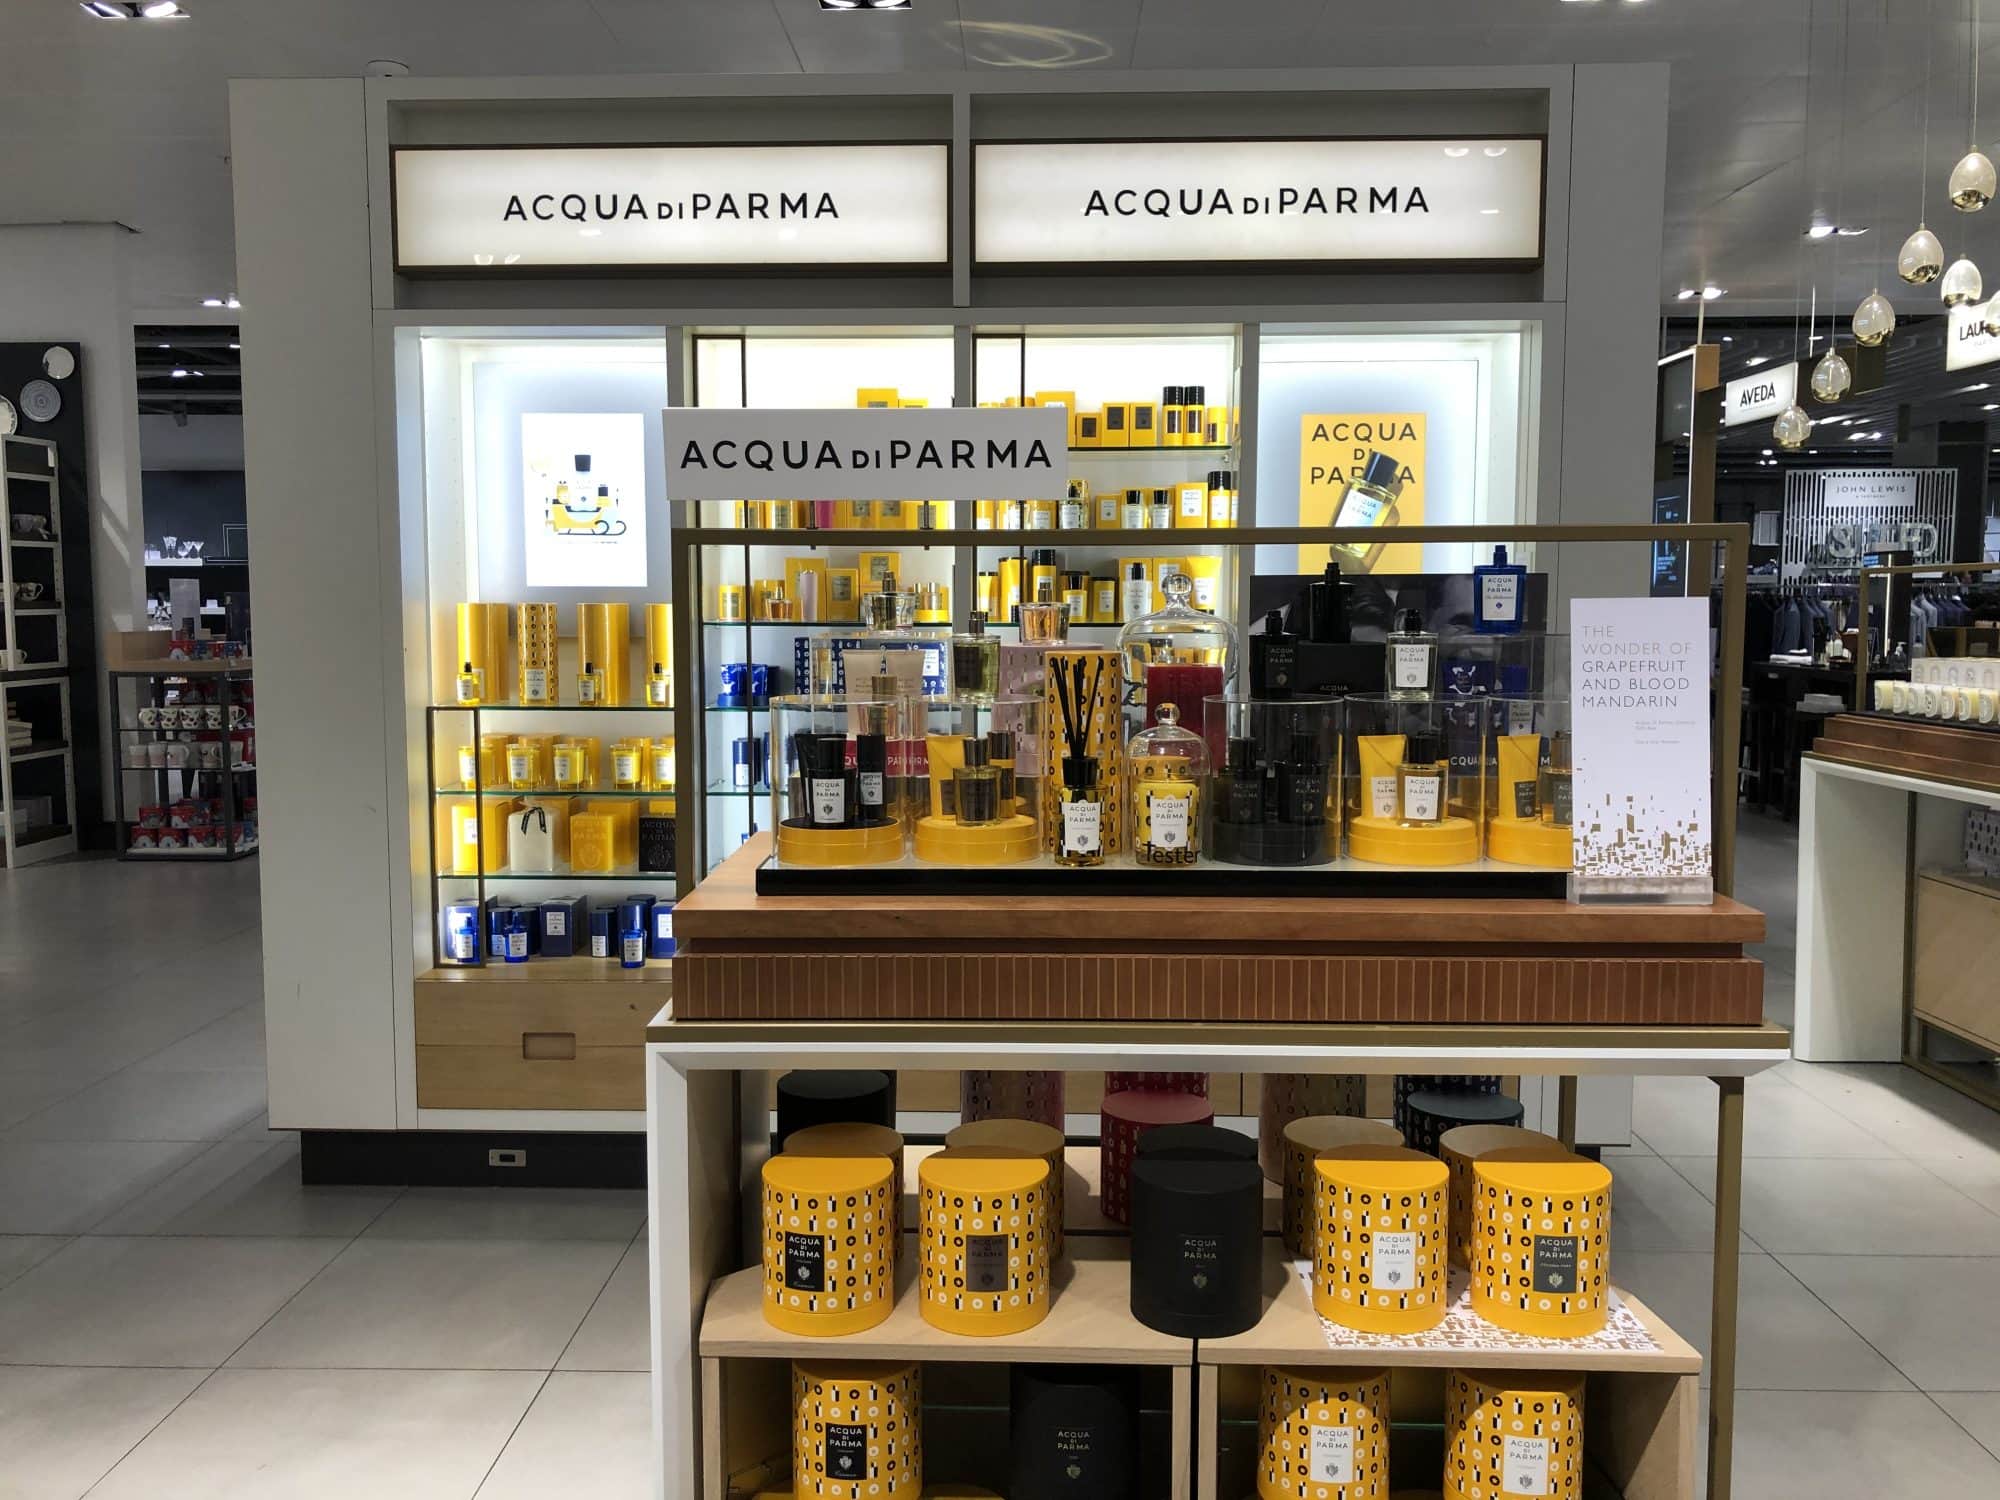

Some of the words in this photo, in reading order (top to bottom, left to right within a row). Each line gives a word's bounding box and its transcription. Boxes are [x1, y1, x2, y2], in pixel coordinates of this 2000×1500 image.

[503, 193, 648, 222] ACQUA
[657, 202, 684, 220] DI
[692, 192, 839, 220] PARMA
[1084, 188, 1234, 217] ACQUA
[1243, 197, 1269, 214] DI
[1279, 187, 1429, 214] PARMA
[1740, 382, 1776, 408] AVEDA
[1312, 422, 1416, 443] ACQUA
[680, 440, 842, 471] ACQUA
[852, 450, 881, 469] DI
[890, 439, 1052, 469] PARMA
[1353, 448, 1373, 460] D
[1836, 485, 1866, 494] JOHN
[1871, 485, 1906, 493] LEWIS
[1582, 625, 1616, 638] THE
[1582, 642, 1661, 655] WONDER
[1670, 642, 1693, 655] OF
[1582, 660, 1686, 673] GRAPEFRUIT
[1582, 678, 1621, 690] AND
[1629, 678, 1690, 690] BLOOD
[1582, 695, 1678, 708] MANDARIN
[1156, 802, 1184, 810] ACQUA
[1070, 816, 1096, 824] PARMA
[1142, 840, 1201, 864] Tester
[789, 1236, 820, 1246] ACQUA
[1540, 1238, 1573, 1246] ACQUA
[789, 1248, 820, 1258] PARMA
[1184, 1252, 1217, 1260] PARMA
[1378, 1248, 1410, 1256] PARMA
[1540, 1250, 1573, 1258] PARMA
[830, 1426, 862, 1435] ACQUA
[1058, 1430, 1090, 1438] ACQUA
[1316, 1430, 1349, 1438] ACQUA
[829, 1440, 862, 1448] PARMA
[1316, 1442, 1348, 1450] PARMA
[1510, 1440, 1544, 1449] ACQUA
[1510, 1452, 1544, 1462] PARMA
